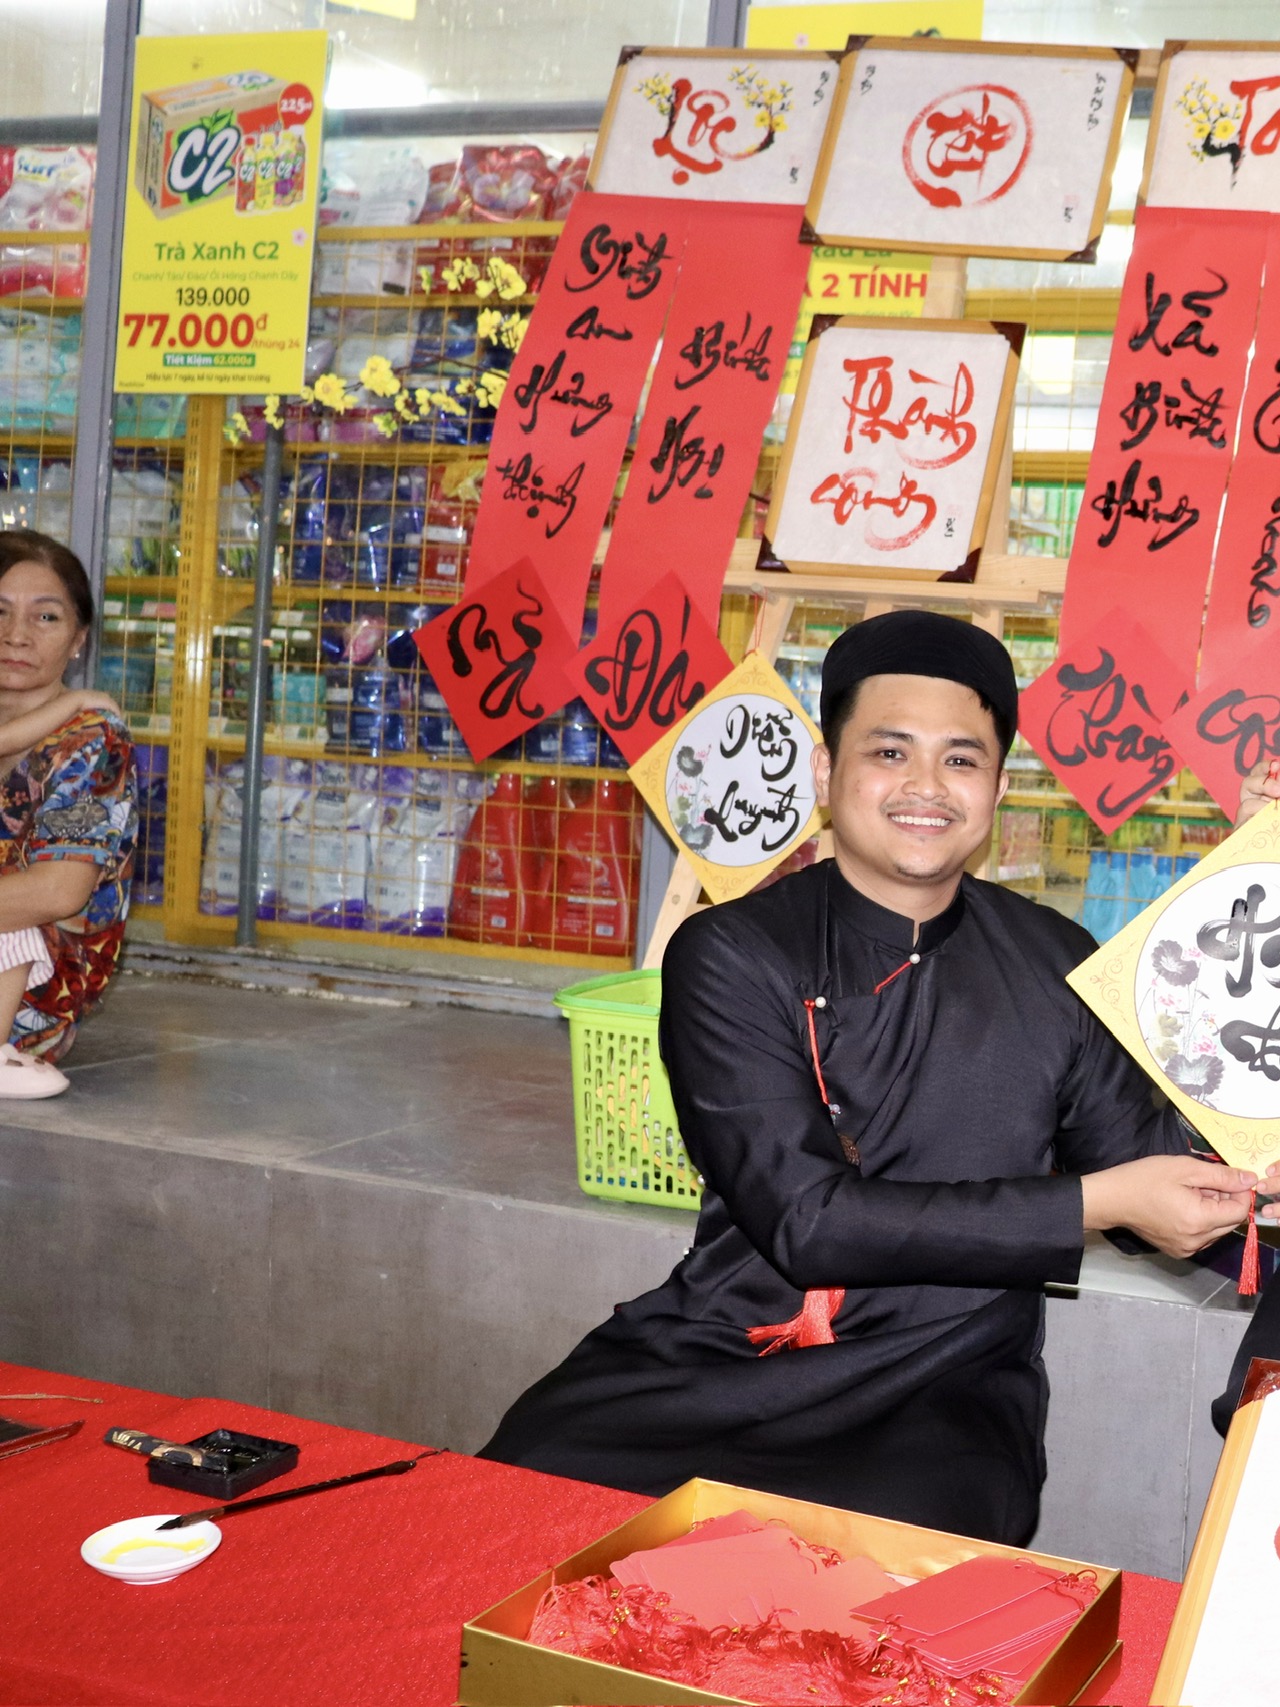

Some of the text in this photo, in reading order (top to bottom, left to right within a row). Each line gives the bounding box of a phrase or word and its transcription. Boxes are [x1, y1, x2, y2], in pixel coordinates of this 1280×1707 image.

[168, 126, 241, 195] C2
[155, 241, 280, 261] Trà Xanh C2
[822, 273, 840, 298] 2
[850, 265, 928, 298] TÍNH
[176, 287, 251, 307] 139.000
[165, 354, 186, 366] Tiết
[186, 354, 213, 367] Kiệm
[843, 356, 977, 469] Thành
